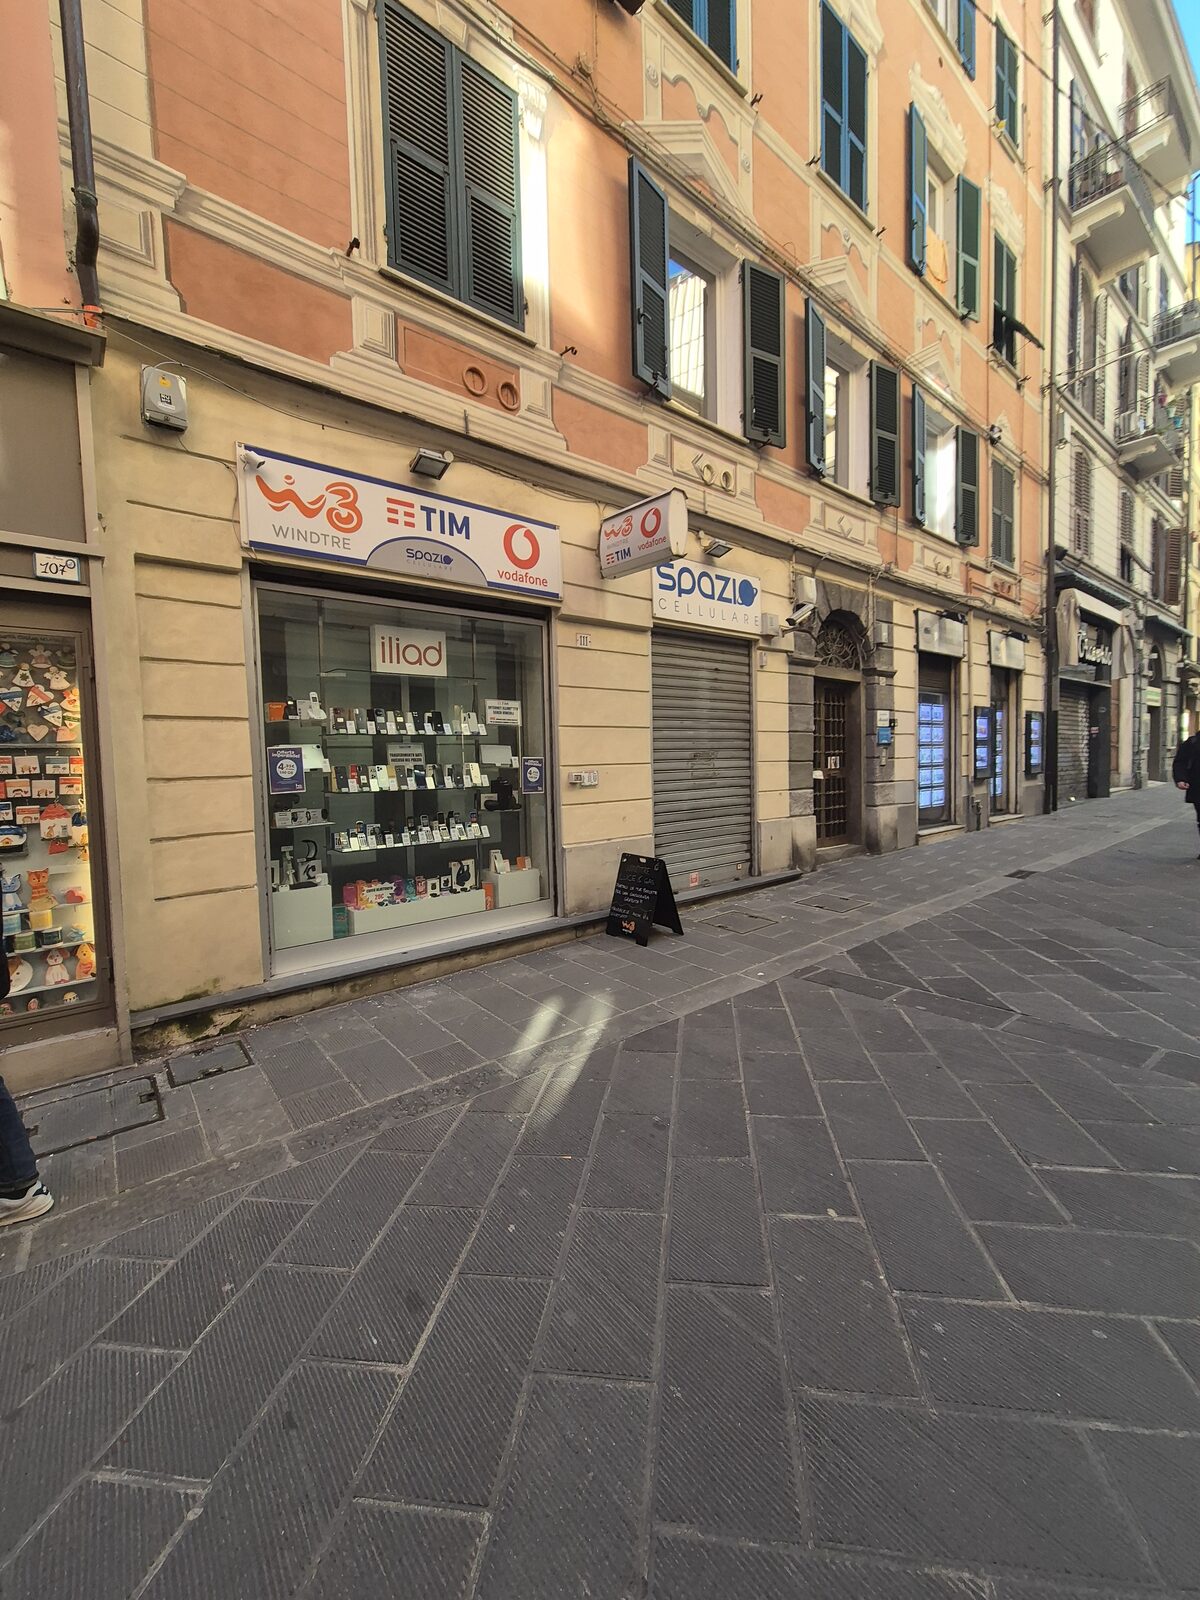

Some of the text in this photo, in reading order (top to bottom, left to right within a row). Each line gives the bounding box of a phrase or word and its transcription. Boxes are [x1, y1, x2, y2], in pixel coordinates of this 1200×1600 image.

[420, 504, 471, 540] TIM
[271, 523, 351, 551] WINDTRE
[637, 535, 667, 551] vodafone
[615, 547, 632, 561] TIM
[497, 568, 549, 588] vodafone
[658, 597, 760, 627] CELLULARE
[380, 635, 443, 667] iliad
